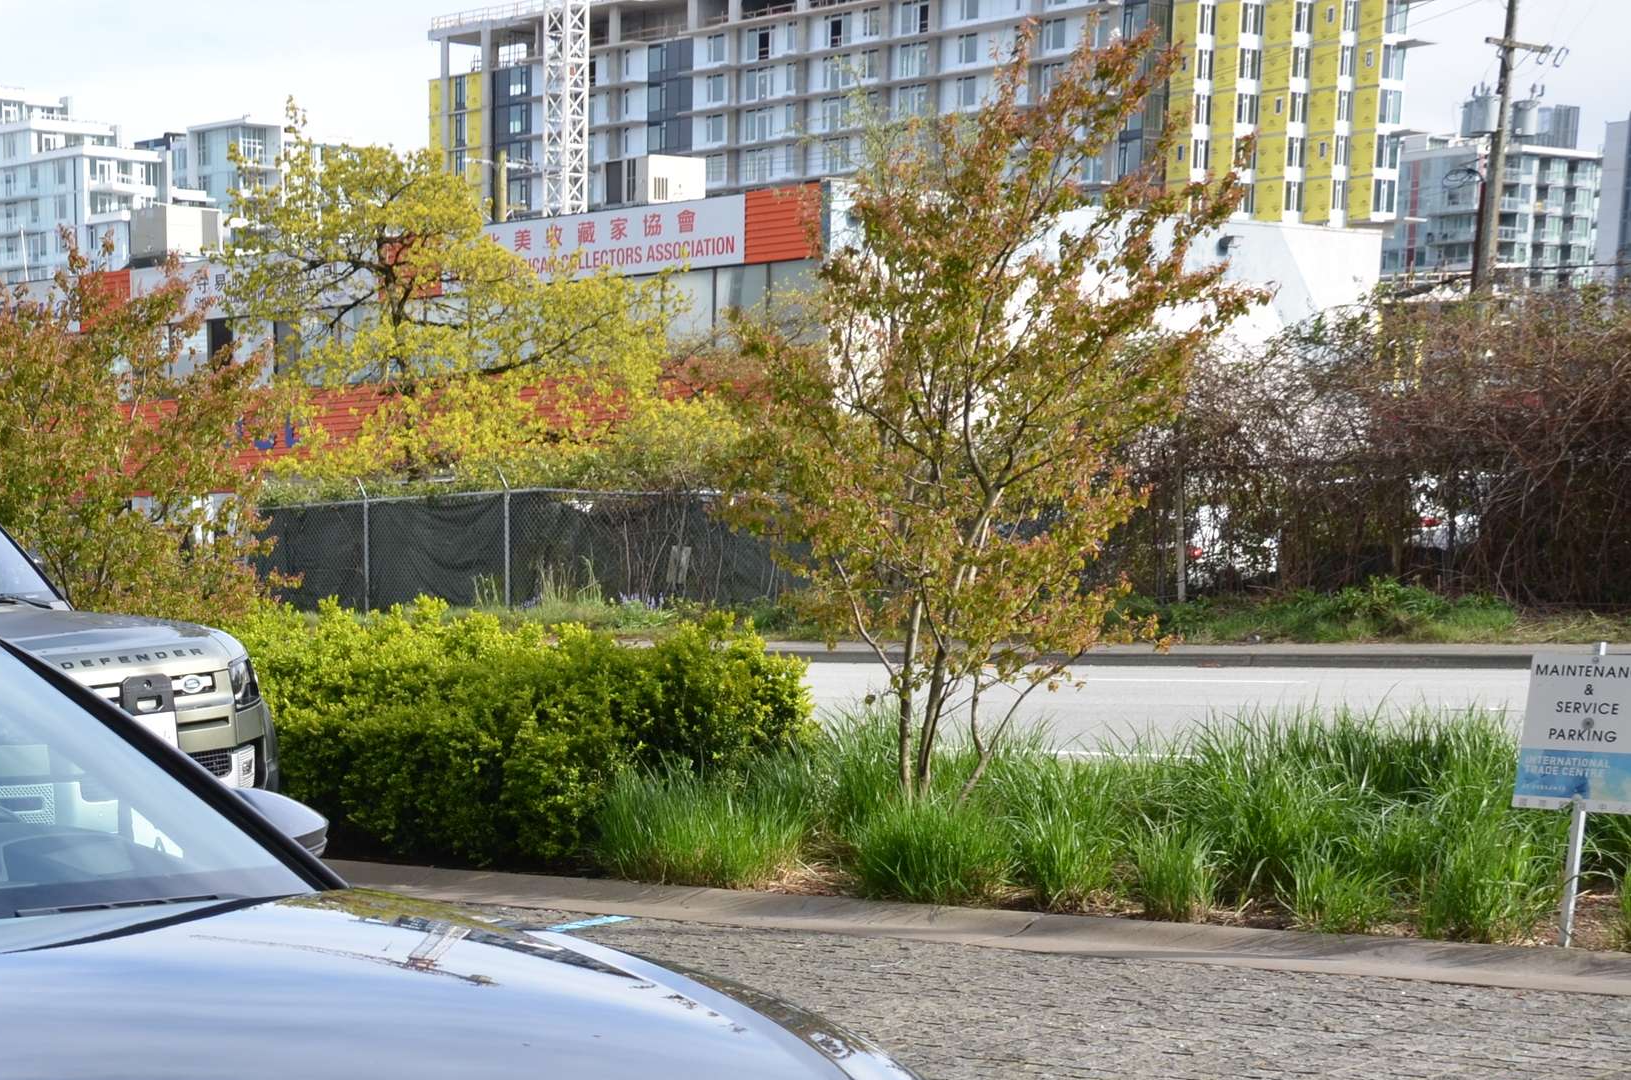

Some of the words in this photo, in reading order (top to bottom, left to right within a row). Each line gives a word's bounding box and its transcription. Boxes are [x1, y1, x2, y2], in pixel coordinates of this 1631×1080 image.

[561, 245, 642, 273] CLLECTORS
[645, 235, 736, 263] ASSOCIATION
[60, 648, 205, 670] DEFENDER
[1535, 664, 1631, 679] MAINTENAN
[1583, 683, 1594, 696] &
[1555, 700, 1620, 715] SERVICE
[1548, 727, 1618, 743] PARKING
[1524, 755, 1611, 769] INTERNATIONAL
[1524, 764, 1558, 776] TRADE
[1561, 766, 1606, 777] CENTRE
